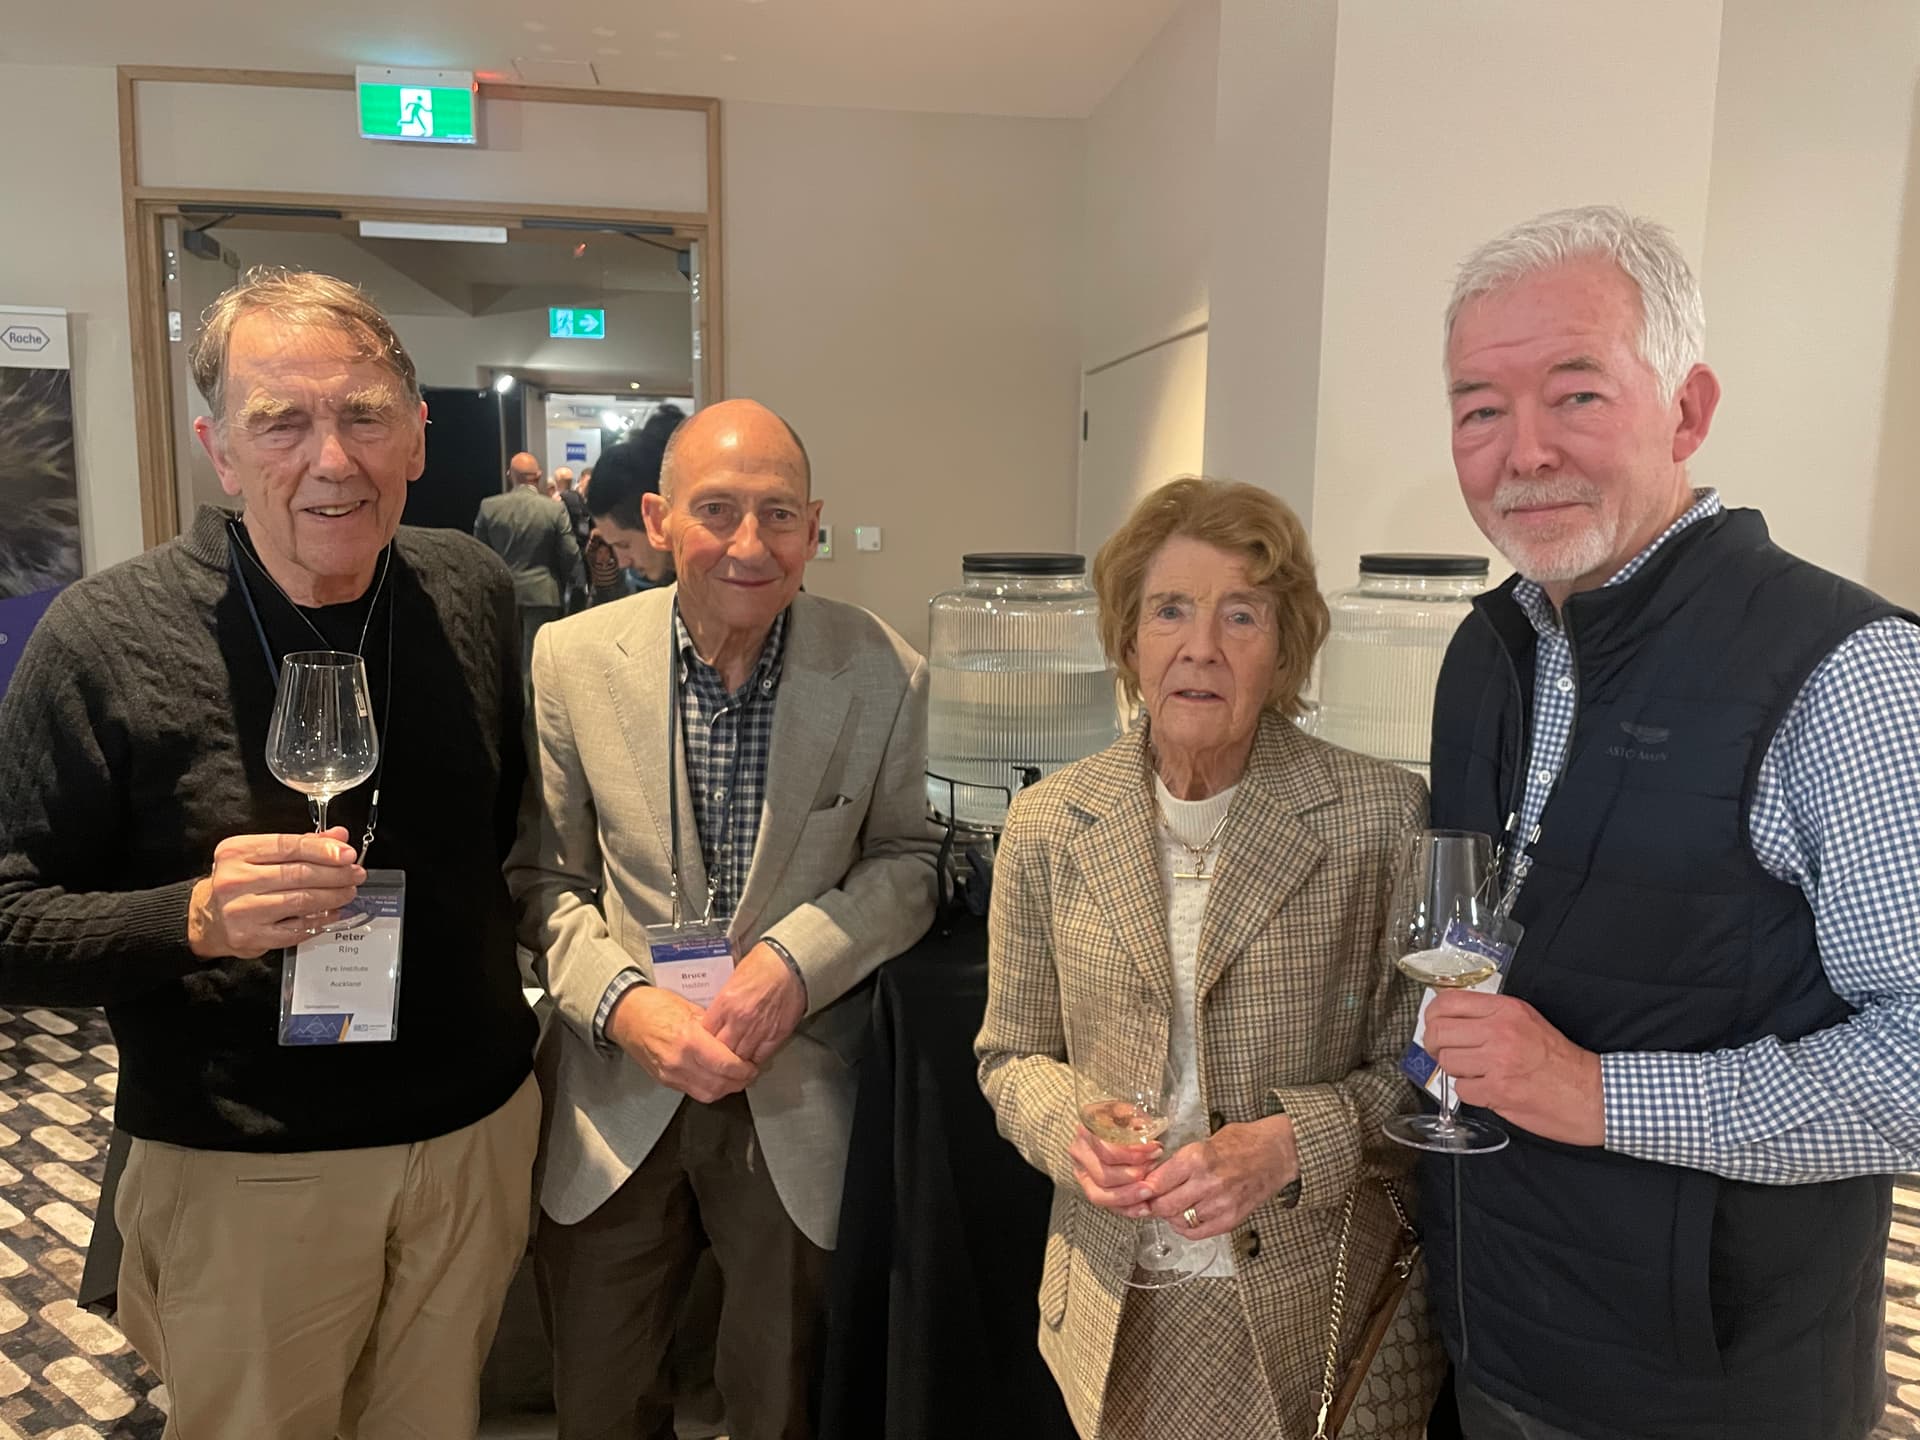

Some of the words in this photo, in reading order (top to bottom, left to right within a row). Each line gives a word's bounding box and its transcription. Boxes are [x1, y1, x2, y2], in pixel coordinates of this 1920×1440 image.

[9, 332, 42, 344] Roche
[335, 932, 365, 942] Peter
[339, 945, 359, 955] Ring
[681, 972, 707, 980] Bruce
